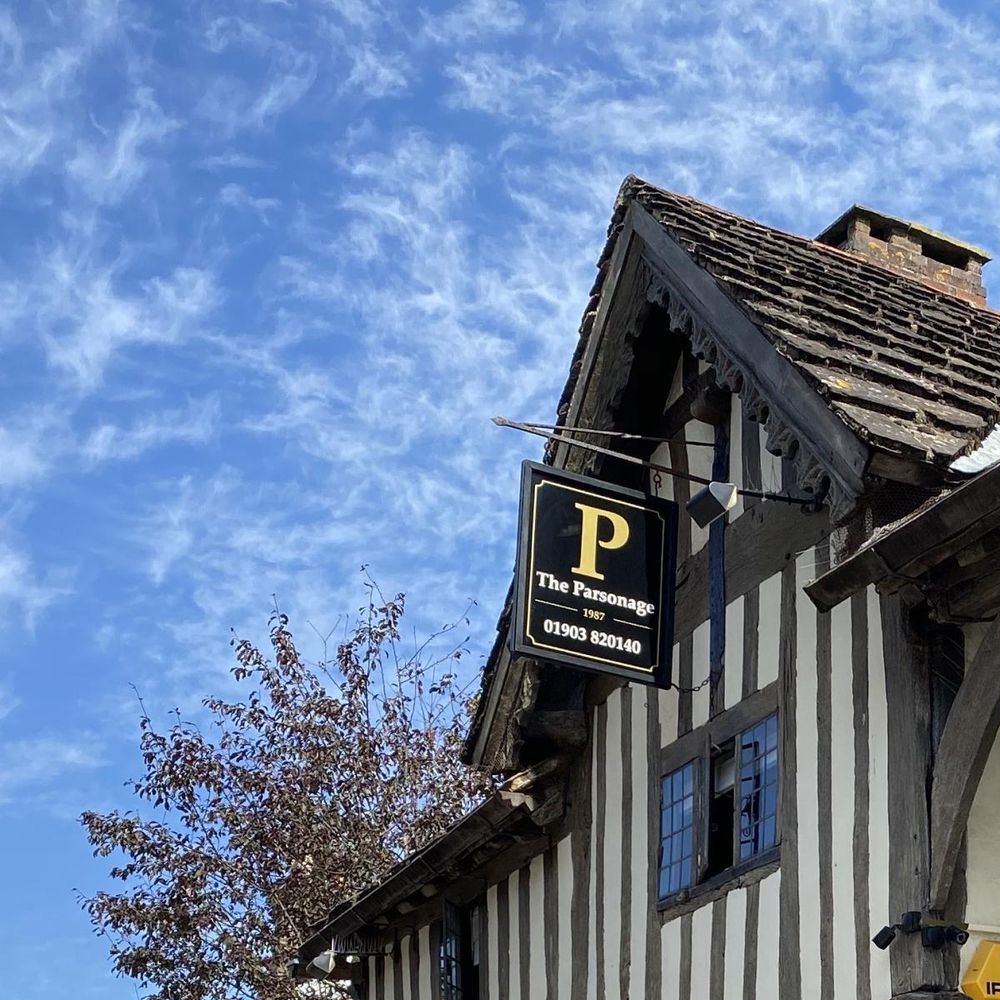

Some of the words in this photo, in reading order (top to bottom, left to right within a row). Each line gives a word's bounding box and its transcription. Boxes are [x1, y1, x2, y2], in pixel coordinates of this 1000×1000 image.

[571, 502, 630, 581] P
[536, 571, 569, 594] The
[573, 580, 655, 617] Parsonage
[583, 608, 605, 621] 1987
[543, 619, 587, 641] 01903
[590, 631, 641, 655] 820140
